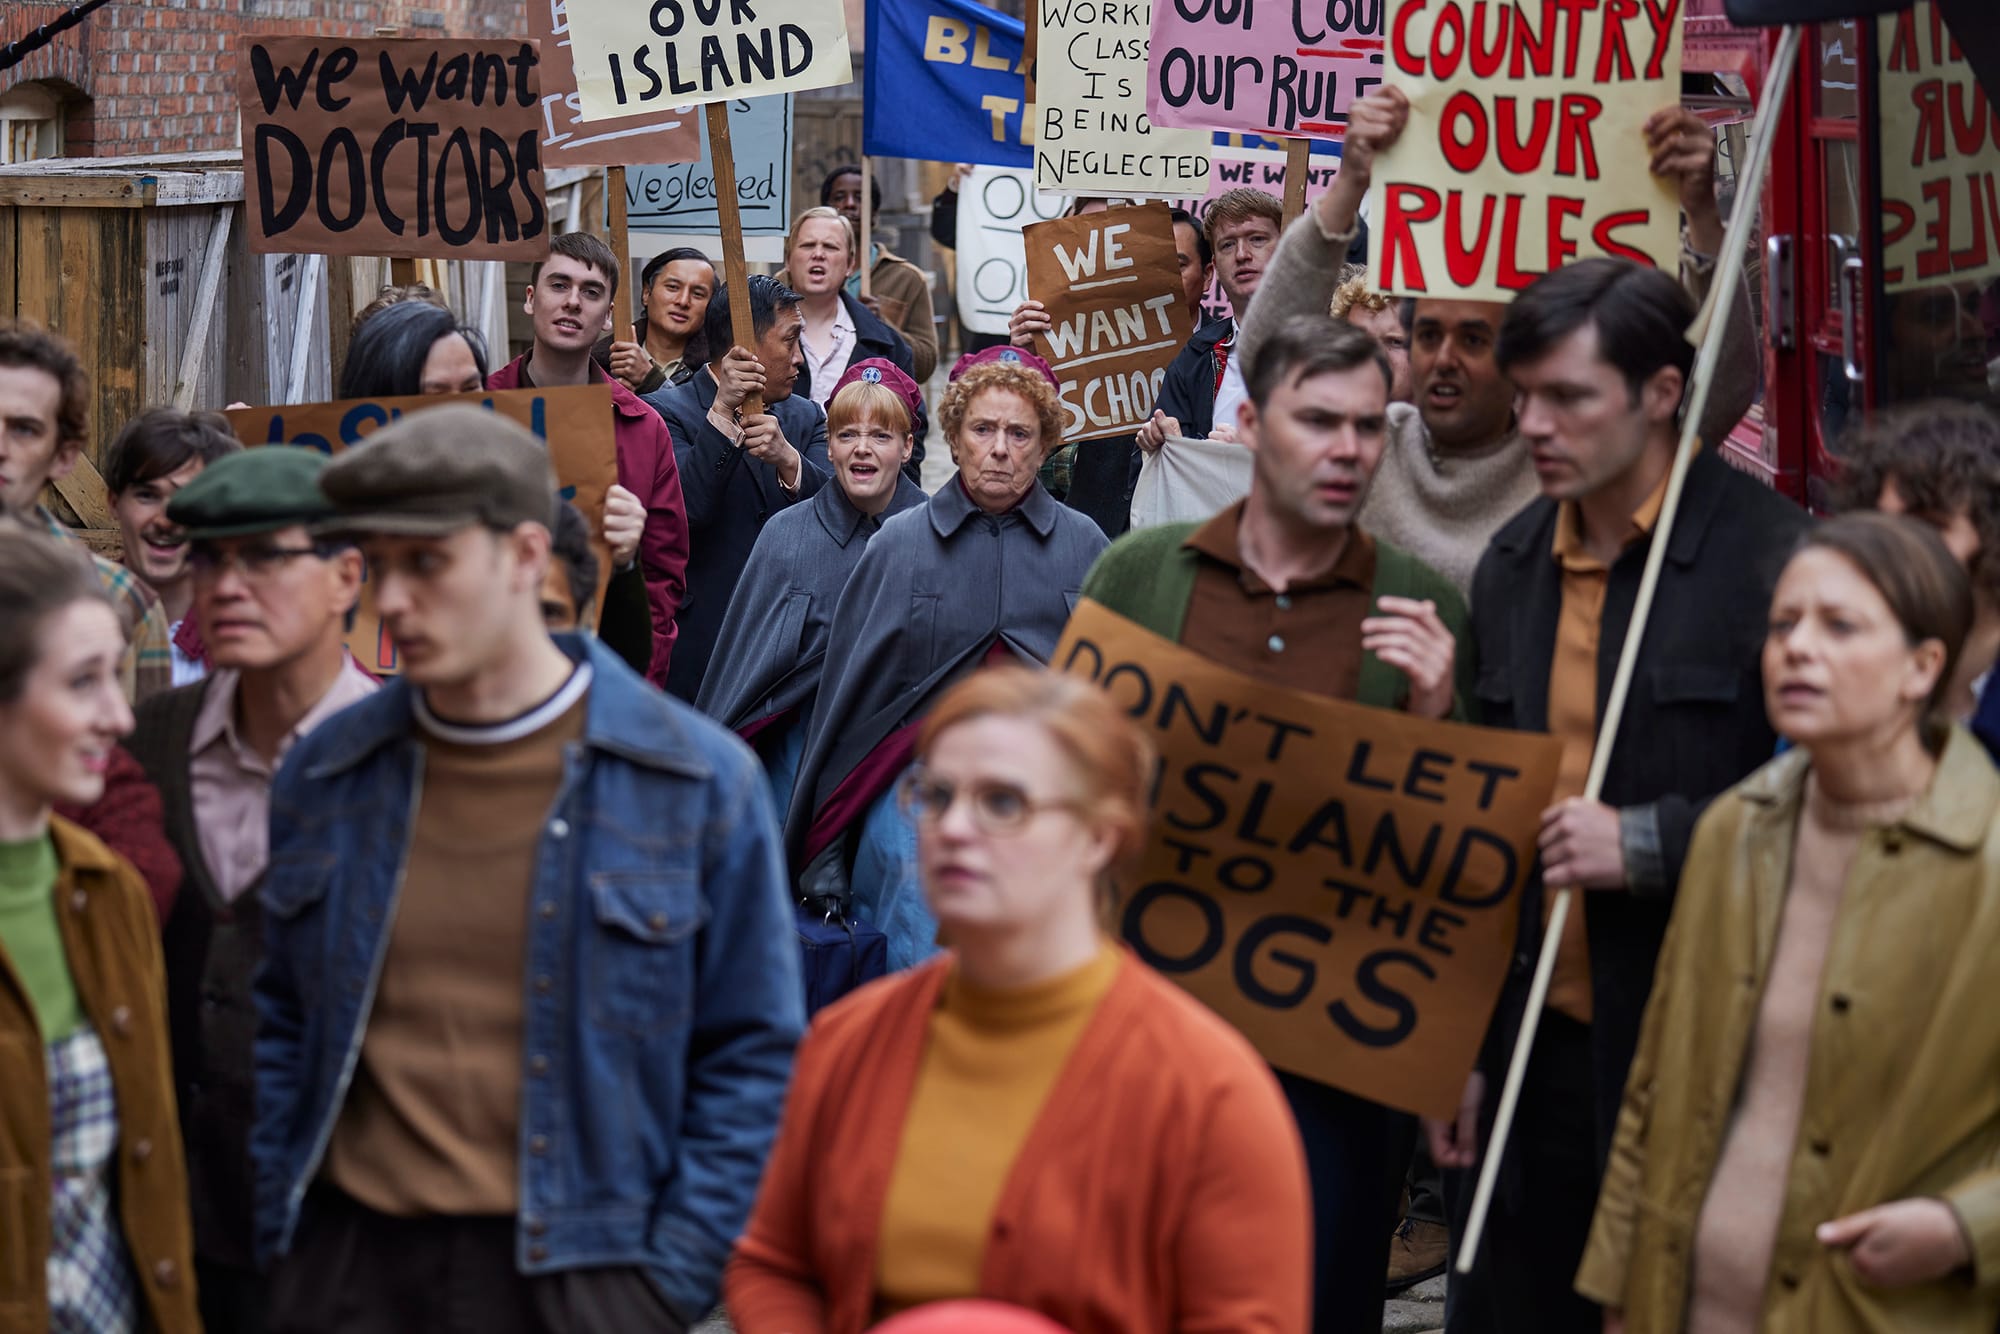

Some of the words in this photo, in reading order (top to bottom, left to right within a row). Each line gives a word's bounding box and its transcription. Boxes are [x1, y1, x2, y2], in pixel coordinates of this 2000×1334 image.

[1042, 0, 1150, 28] WORKI
[1391, 0, 1680, 83] COUNTRY
[608, 23, 813, 105] ISLAND
[1044, 107, 1151, 140] BEING
[1438, 90, 1603, 180] OUR
[255, 118, 544, 246] DOCTORS
[625, 162, 777, 211] Negleced
[1037, 149, 1210, 184] NEGLECTED
[1219, 162, 1256, 184] WE
[1263, 165, 1337, 188] WNT
[1053, 223, 1134, 282] WE
[1379, 182, 1656, 292] RULES
[1043, 294, 1175, 359] WANT
[1057, 367, 1167, 438] SCHO
[1063, 638, 1314, 764] DON'T
[1345, 740, 1521, 811] LET
[1159, 836, 1275, 894] TO
[1322, 879, 1469, 957] THE
[1121, 880, 1438, 1048] OGS
